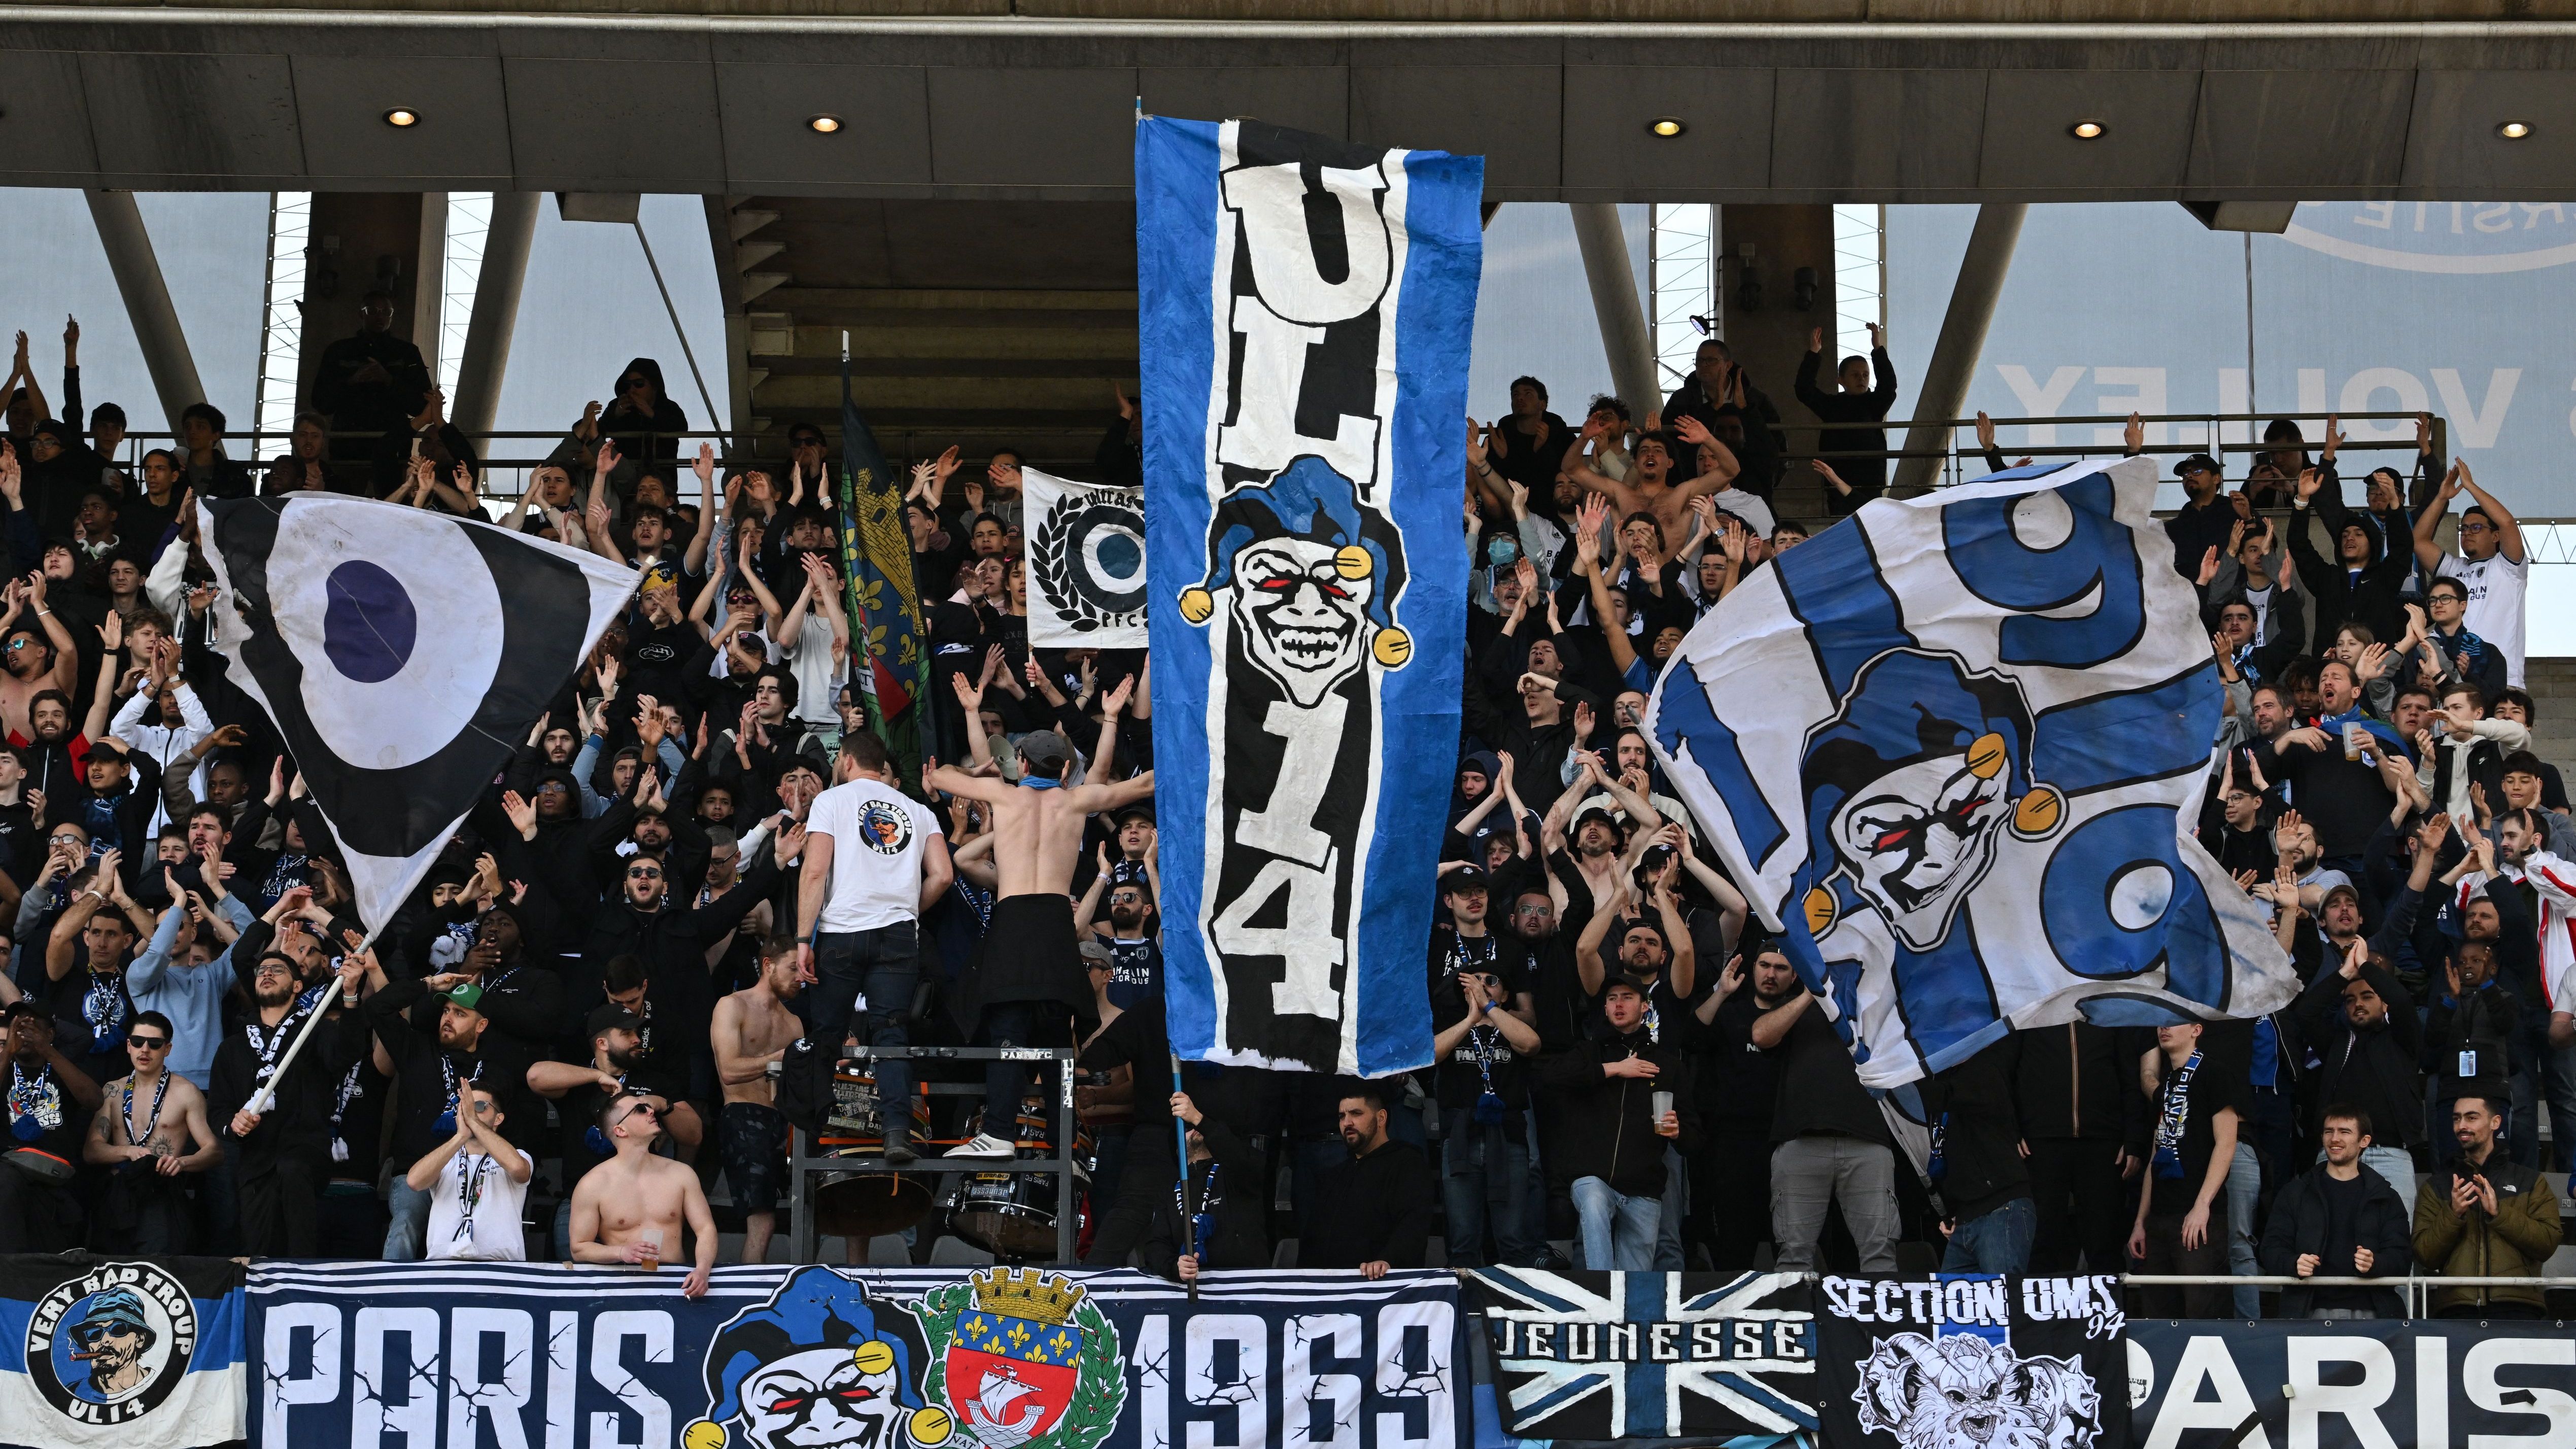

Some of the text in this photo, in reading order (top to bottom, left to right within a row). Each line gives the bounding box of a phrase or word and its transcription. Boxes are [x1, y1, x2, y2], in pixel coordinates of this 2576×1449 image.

[1084, 489, 1138, 508] ultras
[858, 800, 912, 835] VERY BAD TROUP
[973, 1187, 1008, 1196] JEUNESSE
[1024, 1174, 1049, 1187] PARIS FC
[30, 1267, 194, 1355] VERY BAD TROUP
[1822, 1275, 2009, 1326] SECTION
[1494, 1321, 1806, 1360] JEUNESSE
[2085, 1312, 2126, 1341] 94
[262, 1302, 674, 1449] PARIS
[1132, 1300, 1456, 1449] 1969
